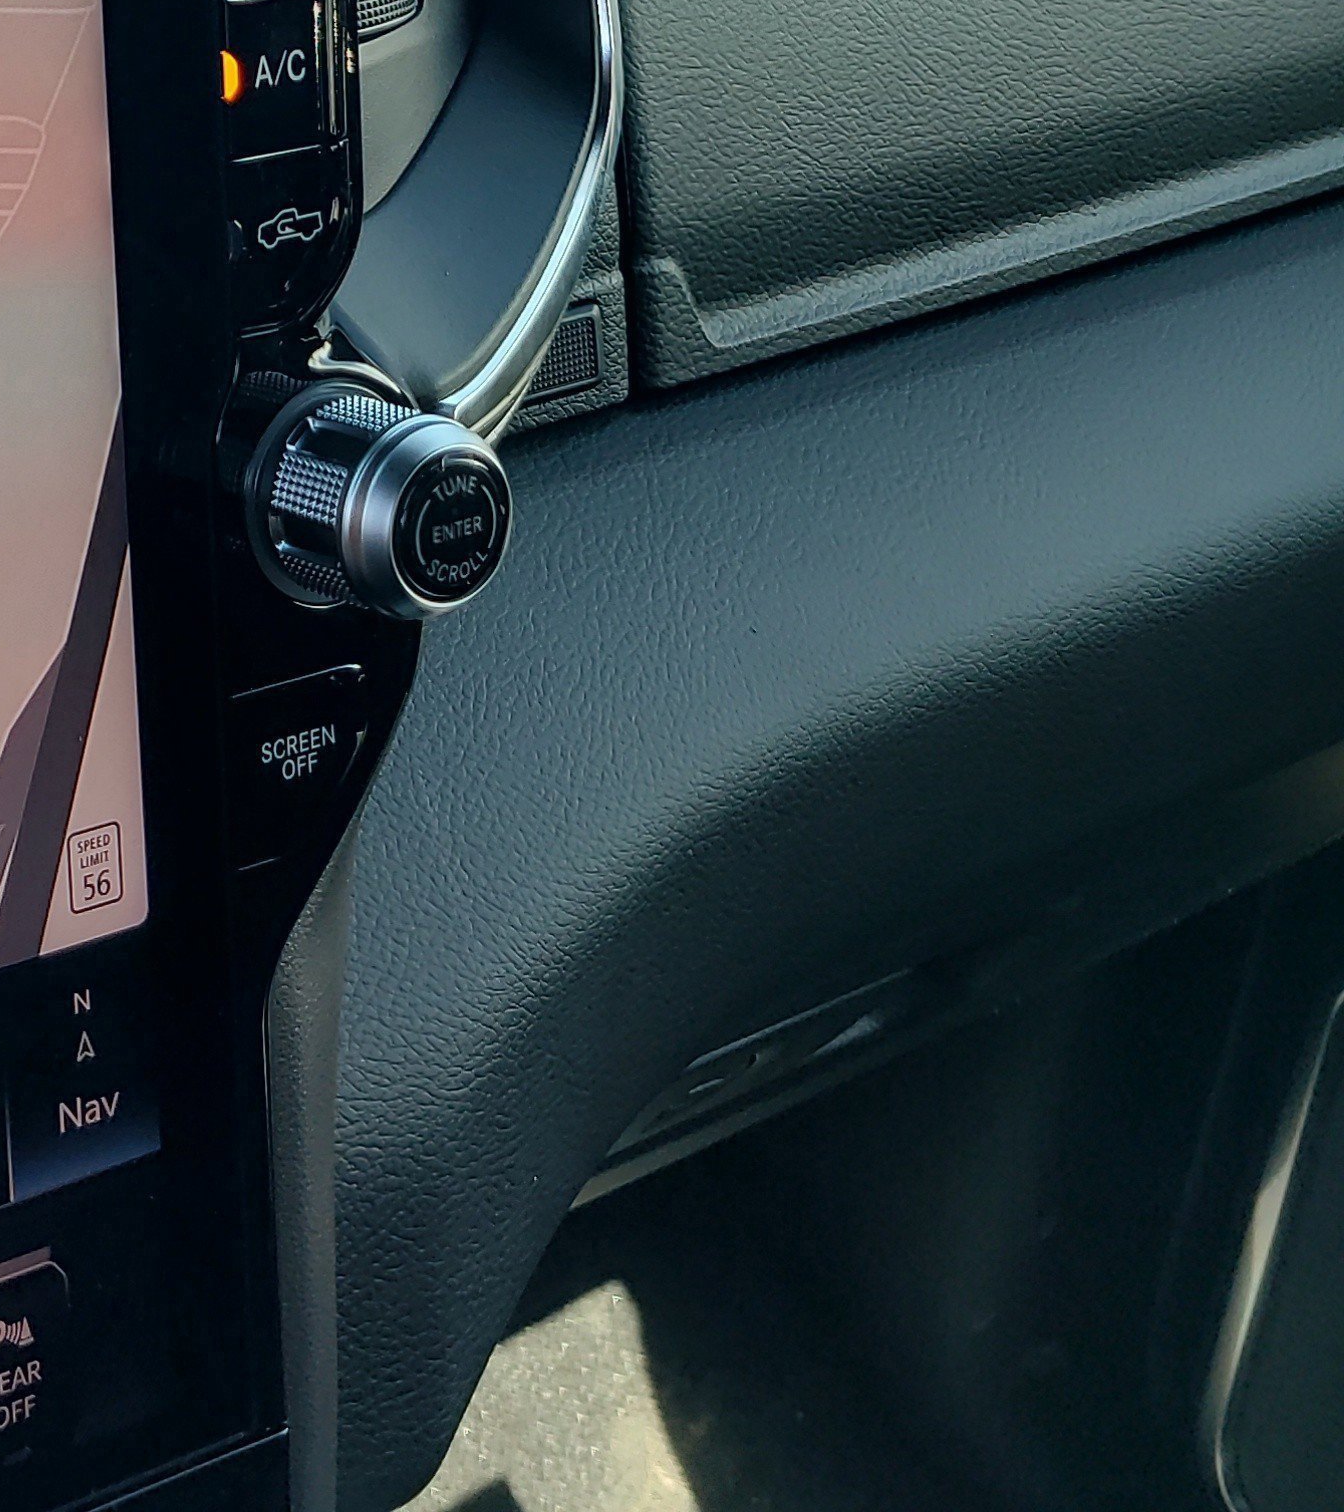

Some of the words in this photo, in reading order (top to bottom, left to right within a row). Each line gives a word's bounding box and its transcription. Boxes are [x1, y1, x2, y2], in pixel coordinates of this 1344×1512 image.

[254, 48, 307, 89] A/C
[432, 474, 479, 501] TUNE
[431, 516, 483, 545] ENTER
[426, 550, 488, 583] SCROLL
[260, 724, 337, 765] SCREEN
[281, 752, 319, 781] OFF
[76, 833, 111, 855] SPEED
[79, 850, 110, 870] LIMIT
[83, 869, 112, 902] 56
[73, 988, 92, 1015] N
[58, 1091, 120, 1135] Nav
